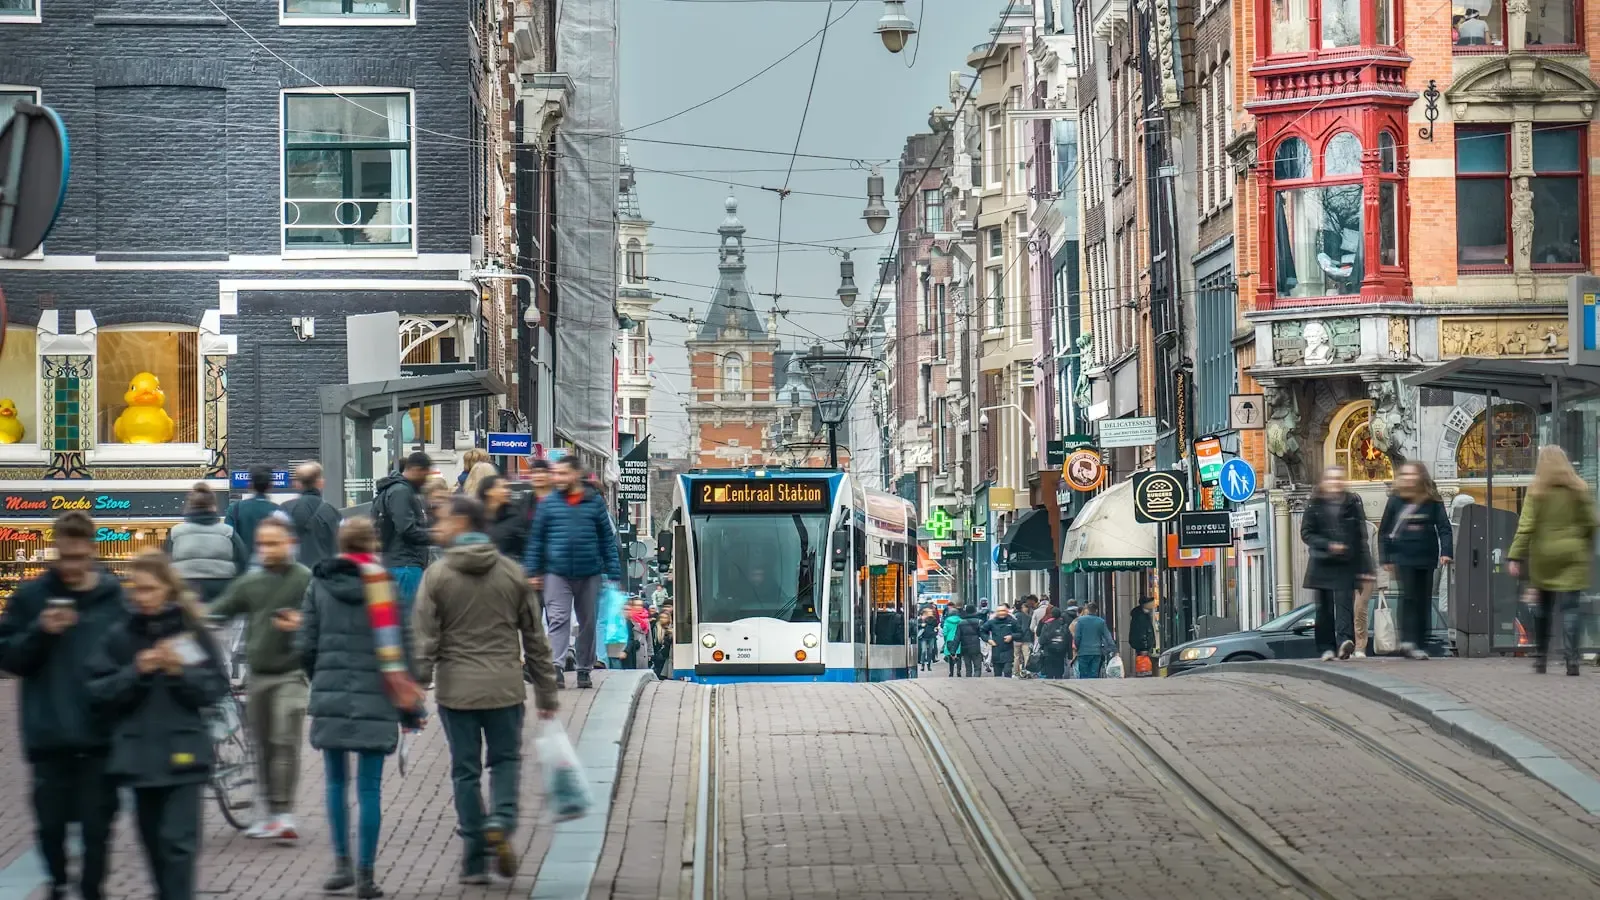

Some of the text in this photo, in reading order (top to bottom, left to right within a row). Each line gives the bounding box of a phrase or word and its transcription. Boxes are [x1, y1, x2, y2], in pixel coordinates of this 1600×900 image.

[1104, 419, 1152, 428] DELICATESSEN
[490, 440, 528, 448] Samsonite
[624, 460, 647, 468] TATTOOS
[625, 467, 647, 475] TATTOOS
[619, 475, 646, 483] ATTOOS &
[625, 492, 646, 500] TATTOOS
[703, 484, 821, 502] 2 Centraal Station
[5, 495, 131, 510] Mama Ducks Store
[0, 527, 37, 541] Mama
[96, 527, 131, 542] Store
